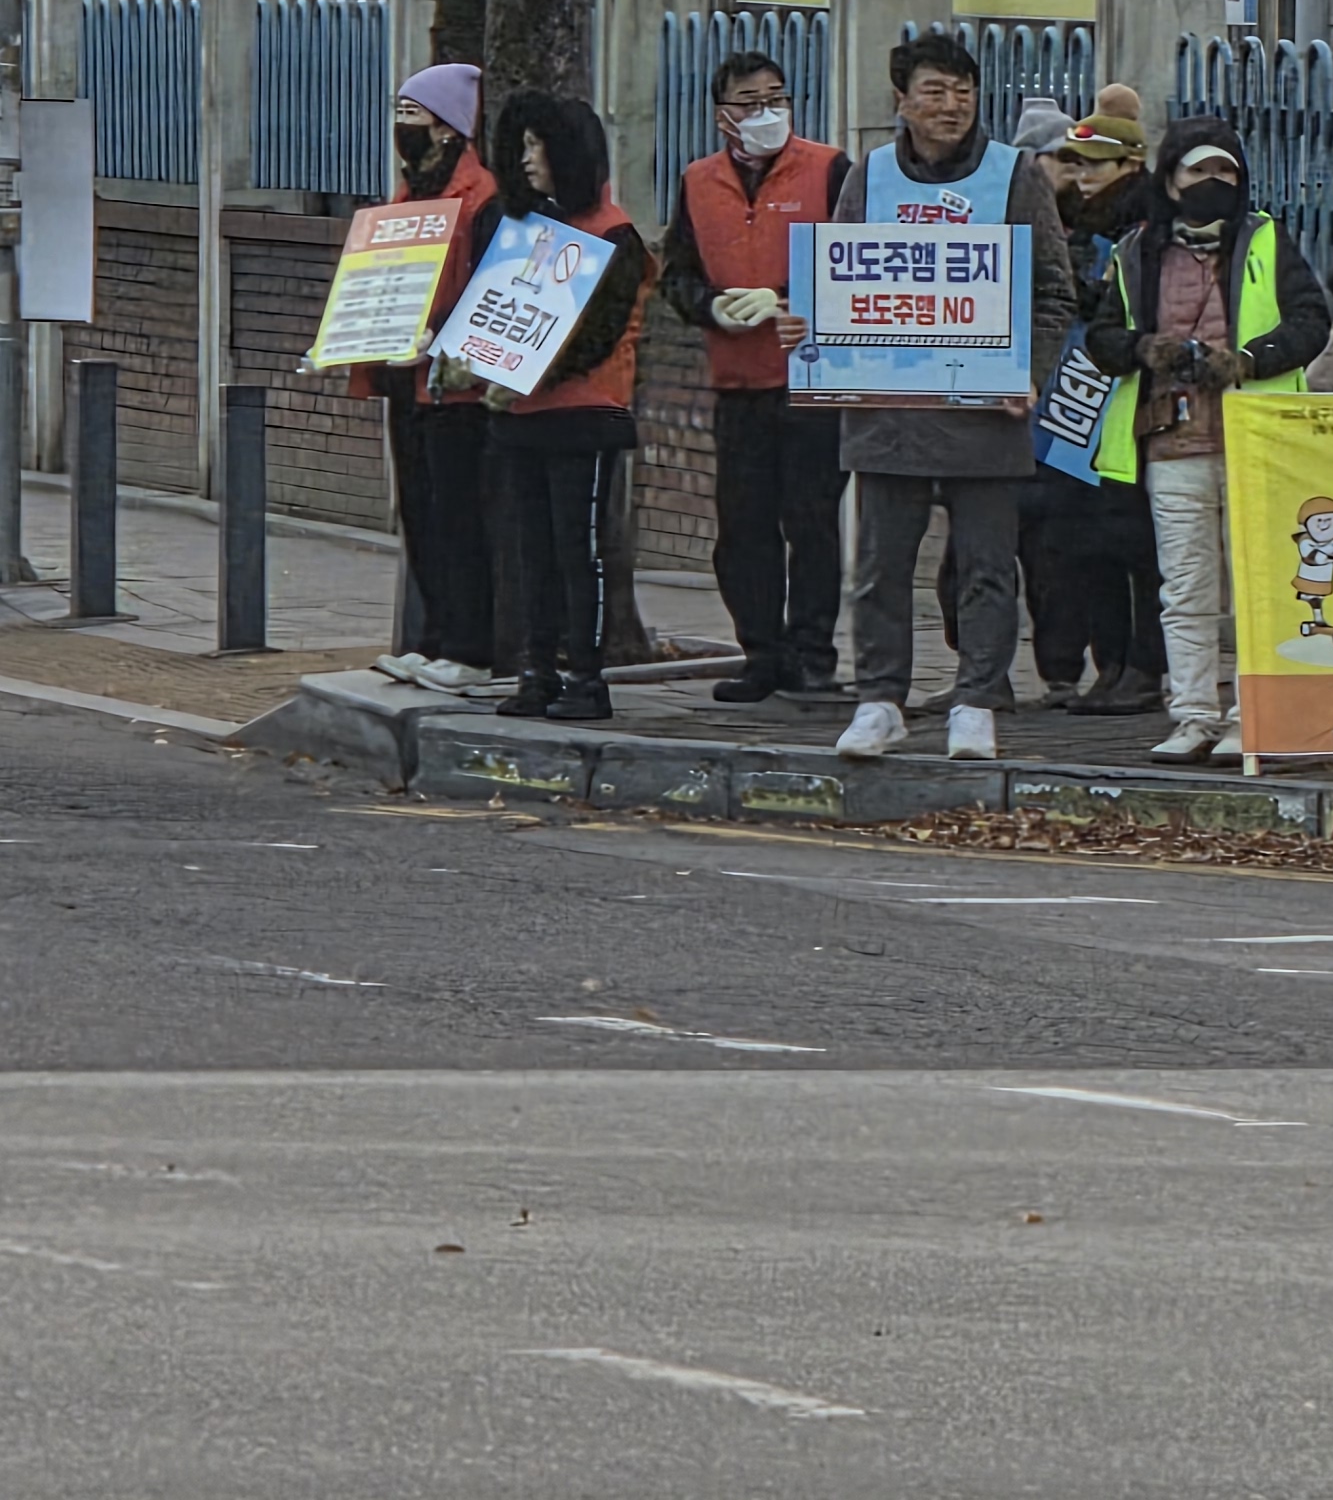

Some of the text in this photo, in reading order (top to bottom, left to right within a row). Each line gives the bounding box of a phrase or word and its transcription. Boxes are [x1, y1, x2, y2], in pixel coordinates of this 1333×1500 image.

[828, 241, 1000, 284] 인도주행 금지
[943, 296, 975, 325] NO
